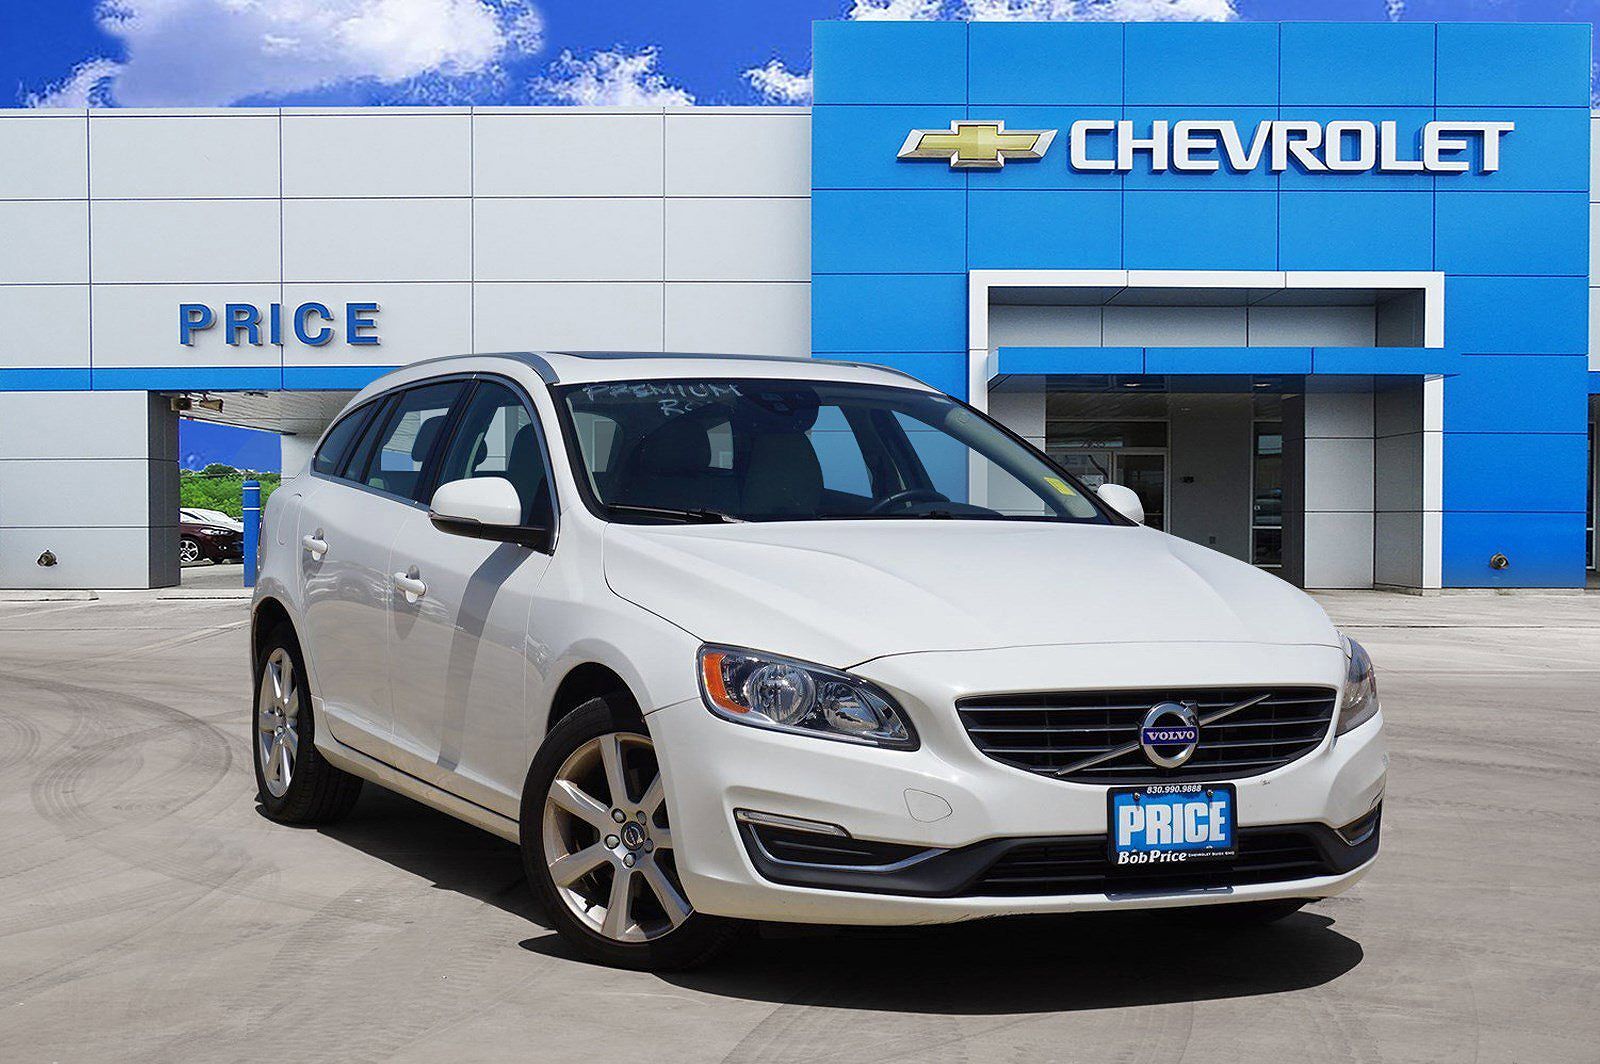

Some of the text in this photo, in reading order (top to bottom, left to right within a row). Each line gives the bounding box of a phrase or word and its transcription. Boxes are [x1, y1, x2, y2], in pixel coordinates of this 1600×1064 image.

[1070, 120, 1515, 171] CHEVROLET
[179, 302, 381, 346] PRICE
[1146, 730, 1195, 741] VOLVO
[1146, 785, 1202, 794] 830.990.9888
[1118, 801, 1226, 846] PRICE
[1118, 850, 1147, 865] Bob
[1148, 849, 1187, 863] Price
